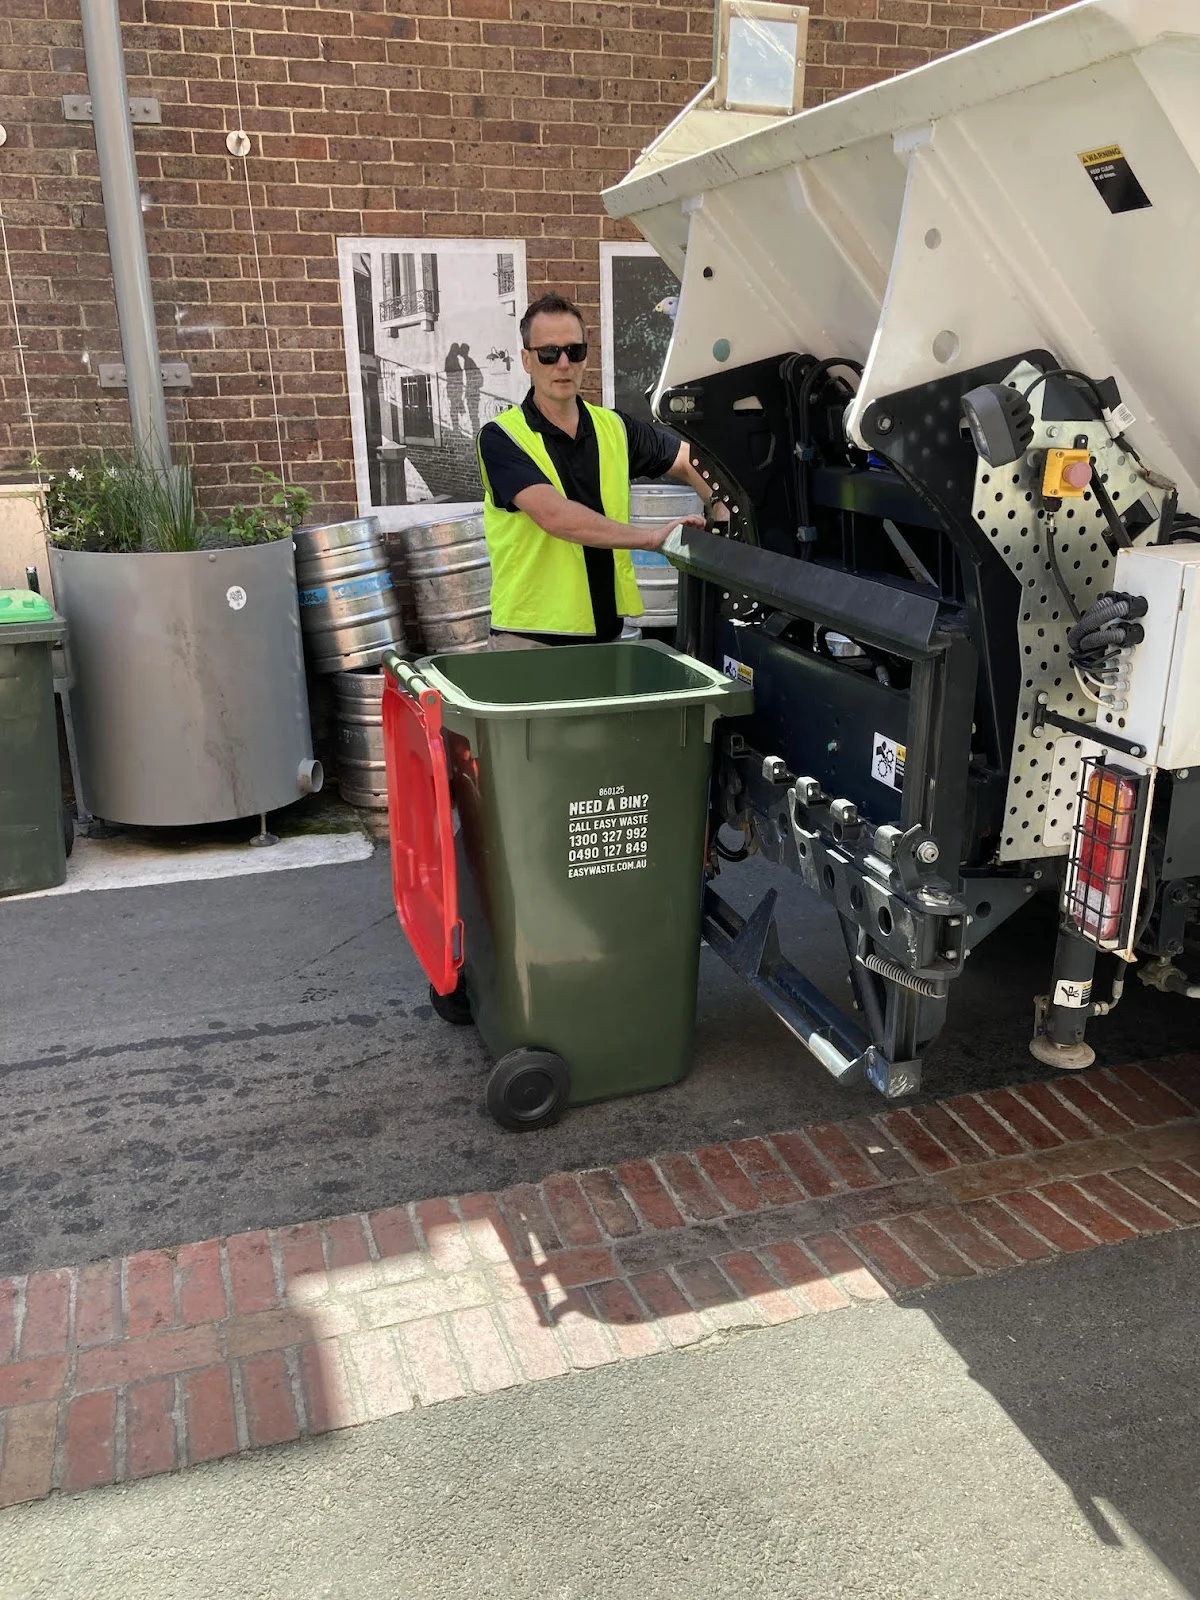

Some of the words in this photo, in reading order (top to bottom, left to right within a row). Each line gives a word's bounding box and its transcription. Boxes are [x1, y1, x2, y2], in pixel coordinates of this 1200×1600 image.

[1086, 147, 1121, 161] WARNING
[599, 785, 625, 796] 860125
[569, 799, 602, 816] NEED
[606, 798, 615, 811] A
[620, 794, 649, 810] BIN?
[569, 821, 591, 833] CALL
[594, 818, 617, 830] EASY
[619, 814, 648, 827] WASTE
[569, 833, 598, 847] 1300
[602, 830, 622, 843] 327
[626, 826, 647, 840] 992
[568, 847, 599, 862] 0490
[603, 844, 622, 857] 127
[625, 841, 647, 854] 849
[568, 859, 647, 878] EASYWASTE.COM.AU
